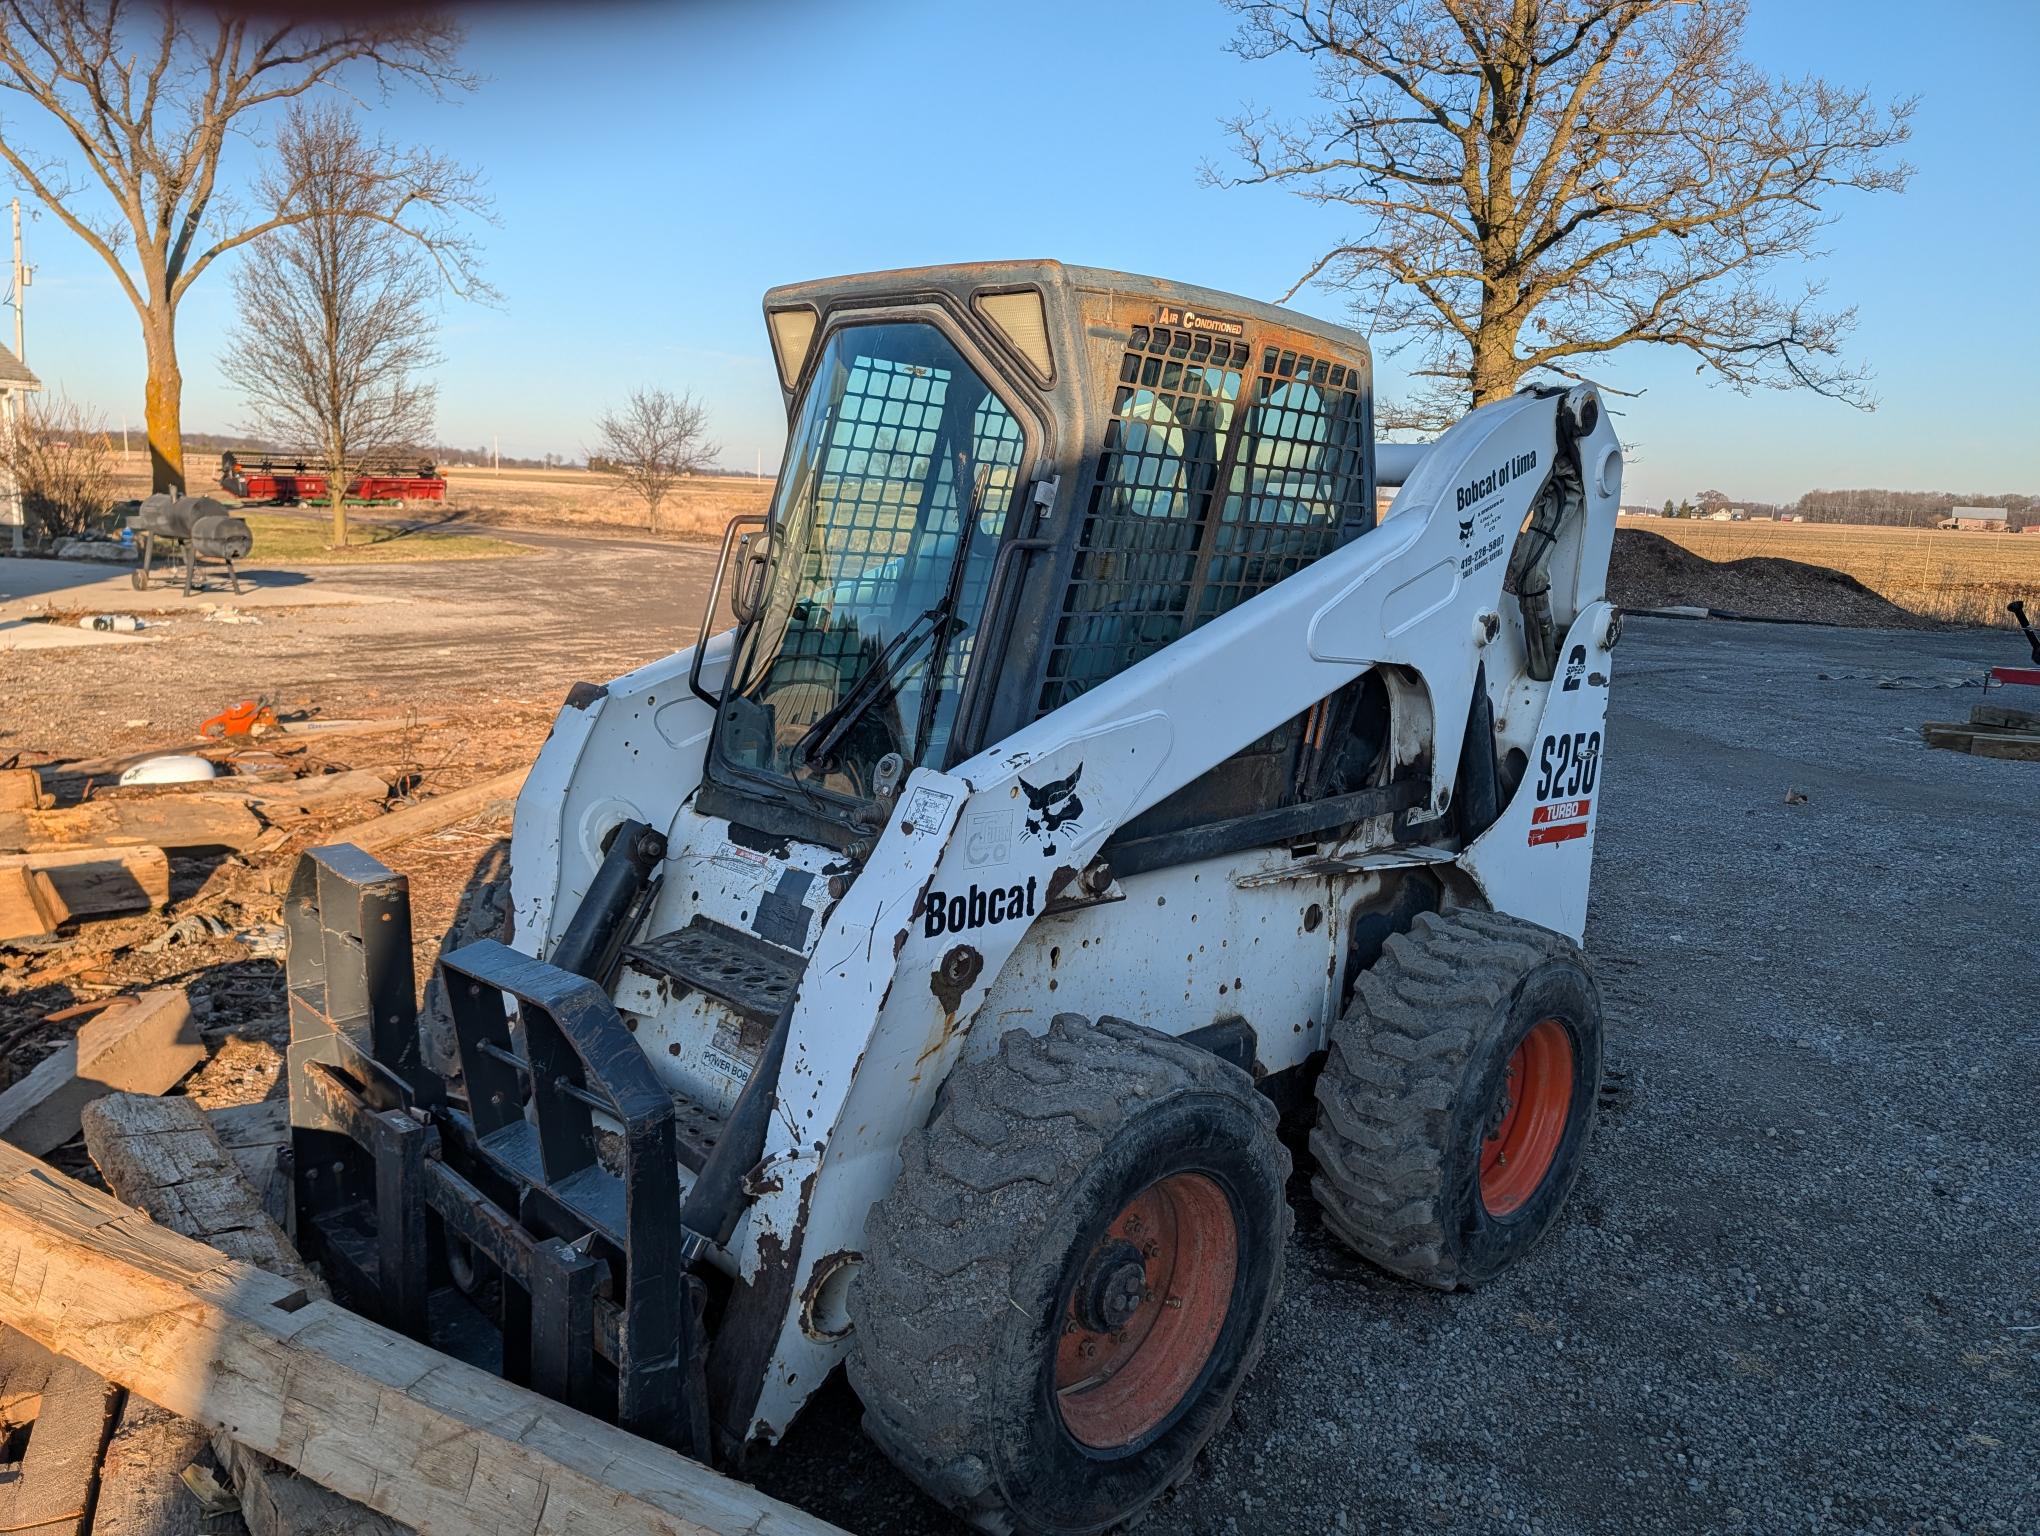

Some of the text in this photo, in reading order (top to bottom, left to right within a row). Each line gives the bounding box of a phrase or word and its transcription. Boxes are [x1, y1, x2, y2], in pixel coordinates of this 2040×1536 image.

[1456, 450, 1537, 512] Bobcat of Lima
[1461, 534, 1504, 569] 419-228-5807
[1562, 644, 1587, 692] 2
[1565, 664, 1586, 676] SPEED
[1536, 731, 1600, 801] S250
[1546, 801, 1579, 821] TURBO
[924, 876, 1037, 938] Bobcat
[703, 1051, 749, 1082] POWER BOB
